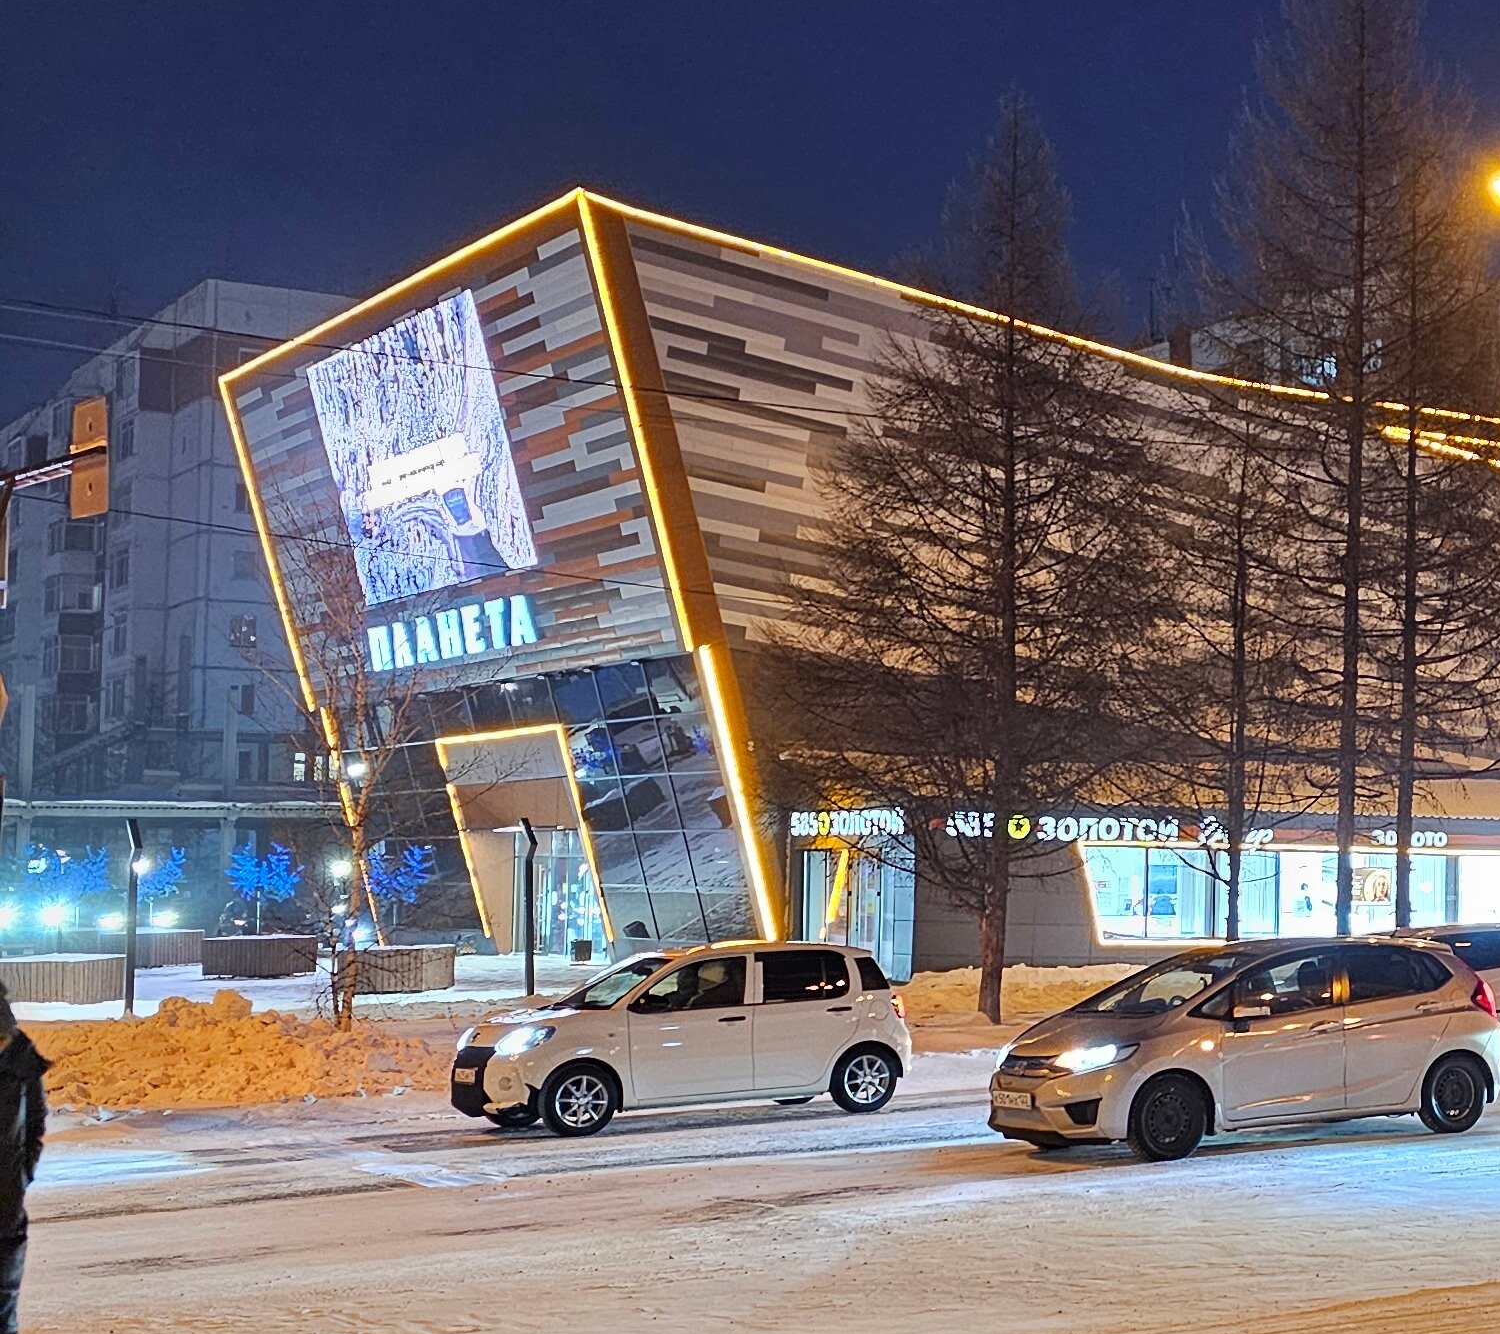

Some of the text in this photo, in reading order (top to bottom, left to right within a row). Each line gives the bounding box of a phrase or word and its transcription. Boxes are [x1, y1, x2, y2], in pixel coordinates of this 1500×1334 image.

[367, 594, 538, 672] ПЛАНЕТА
[1036, 814, 1180, 843] ЗОЛОТОЙ
[1370, 829, 1448, 848] зоото
